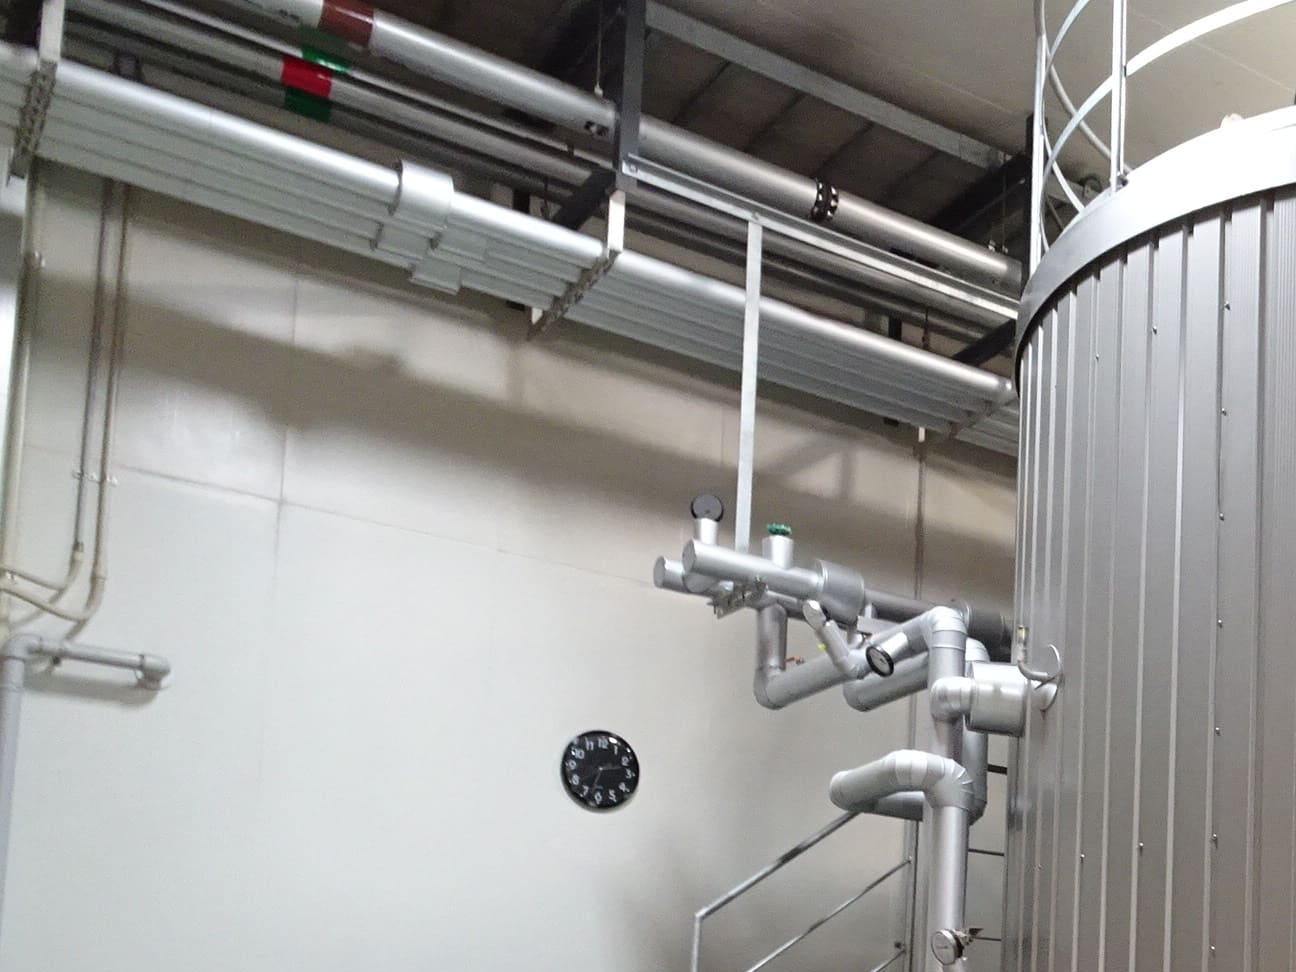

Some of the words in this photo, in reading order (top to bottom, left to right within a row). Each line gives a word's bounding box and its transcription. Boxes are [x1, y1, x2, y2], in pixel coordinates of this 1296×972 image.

[569, 760, 577, 770] 9
[621, 756, 629, 766] 2
[572, 774, 580, 785] 8
[625, 769, 633, 779] 3
[582, 785, 589, 796] 7
[619, 782, 629, 793] 4
[608, 789, 617, 802] 5
